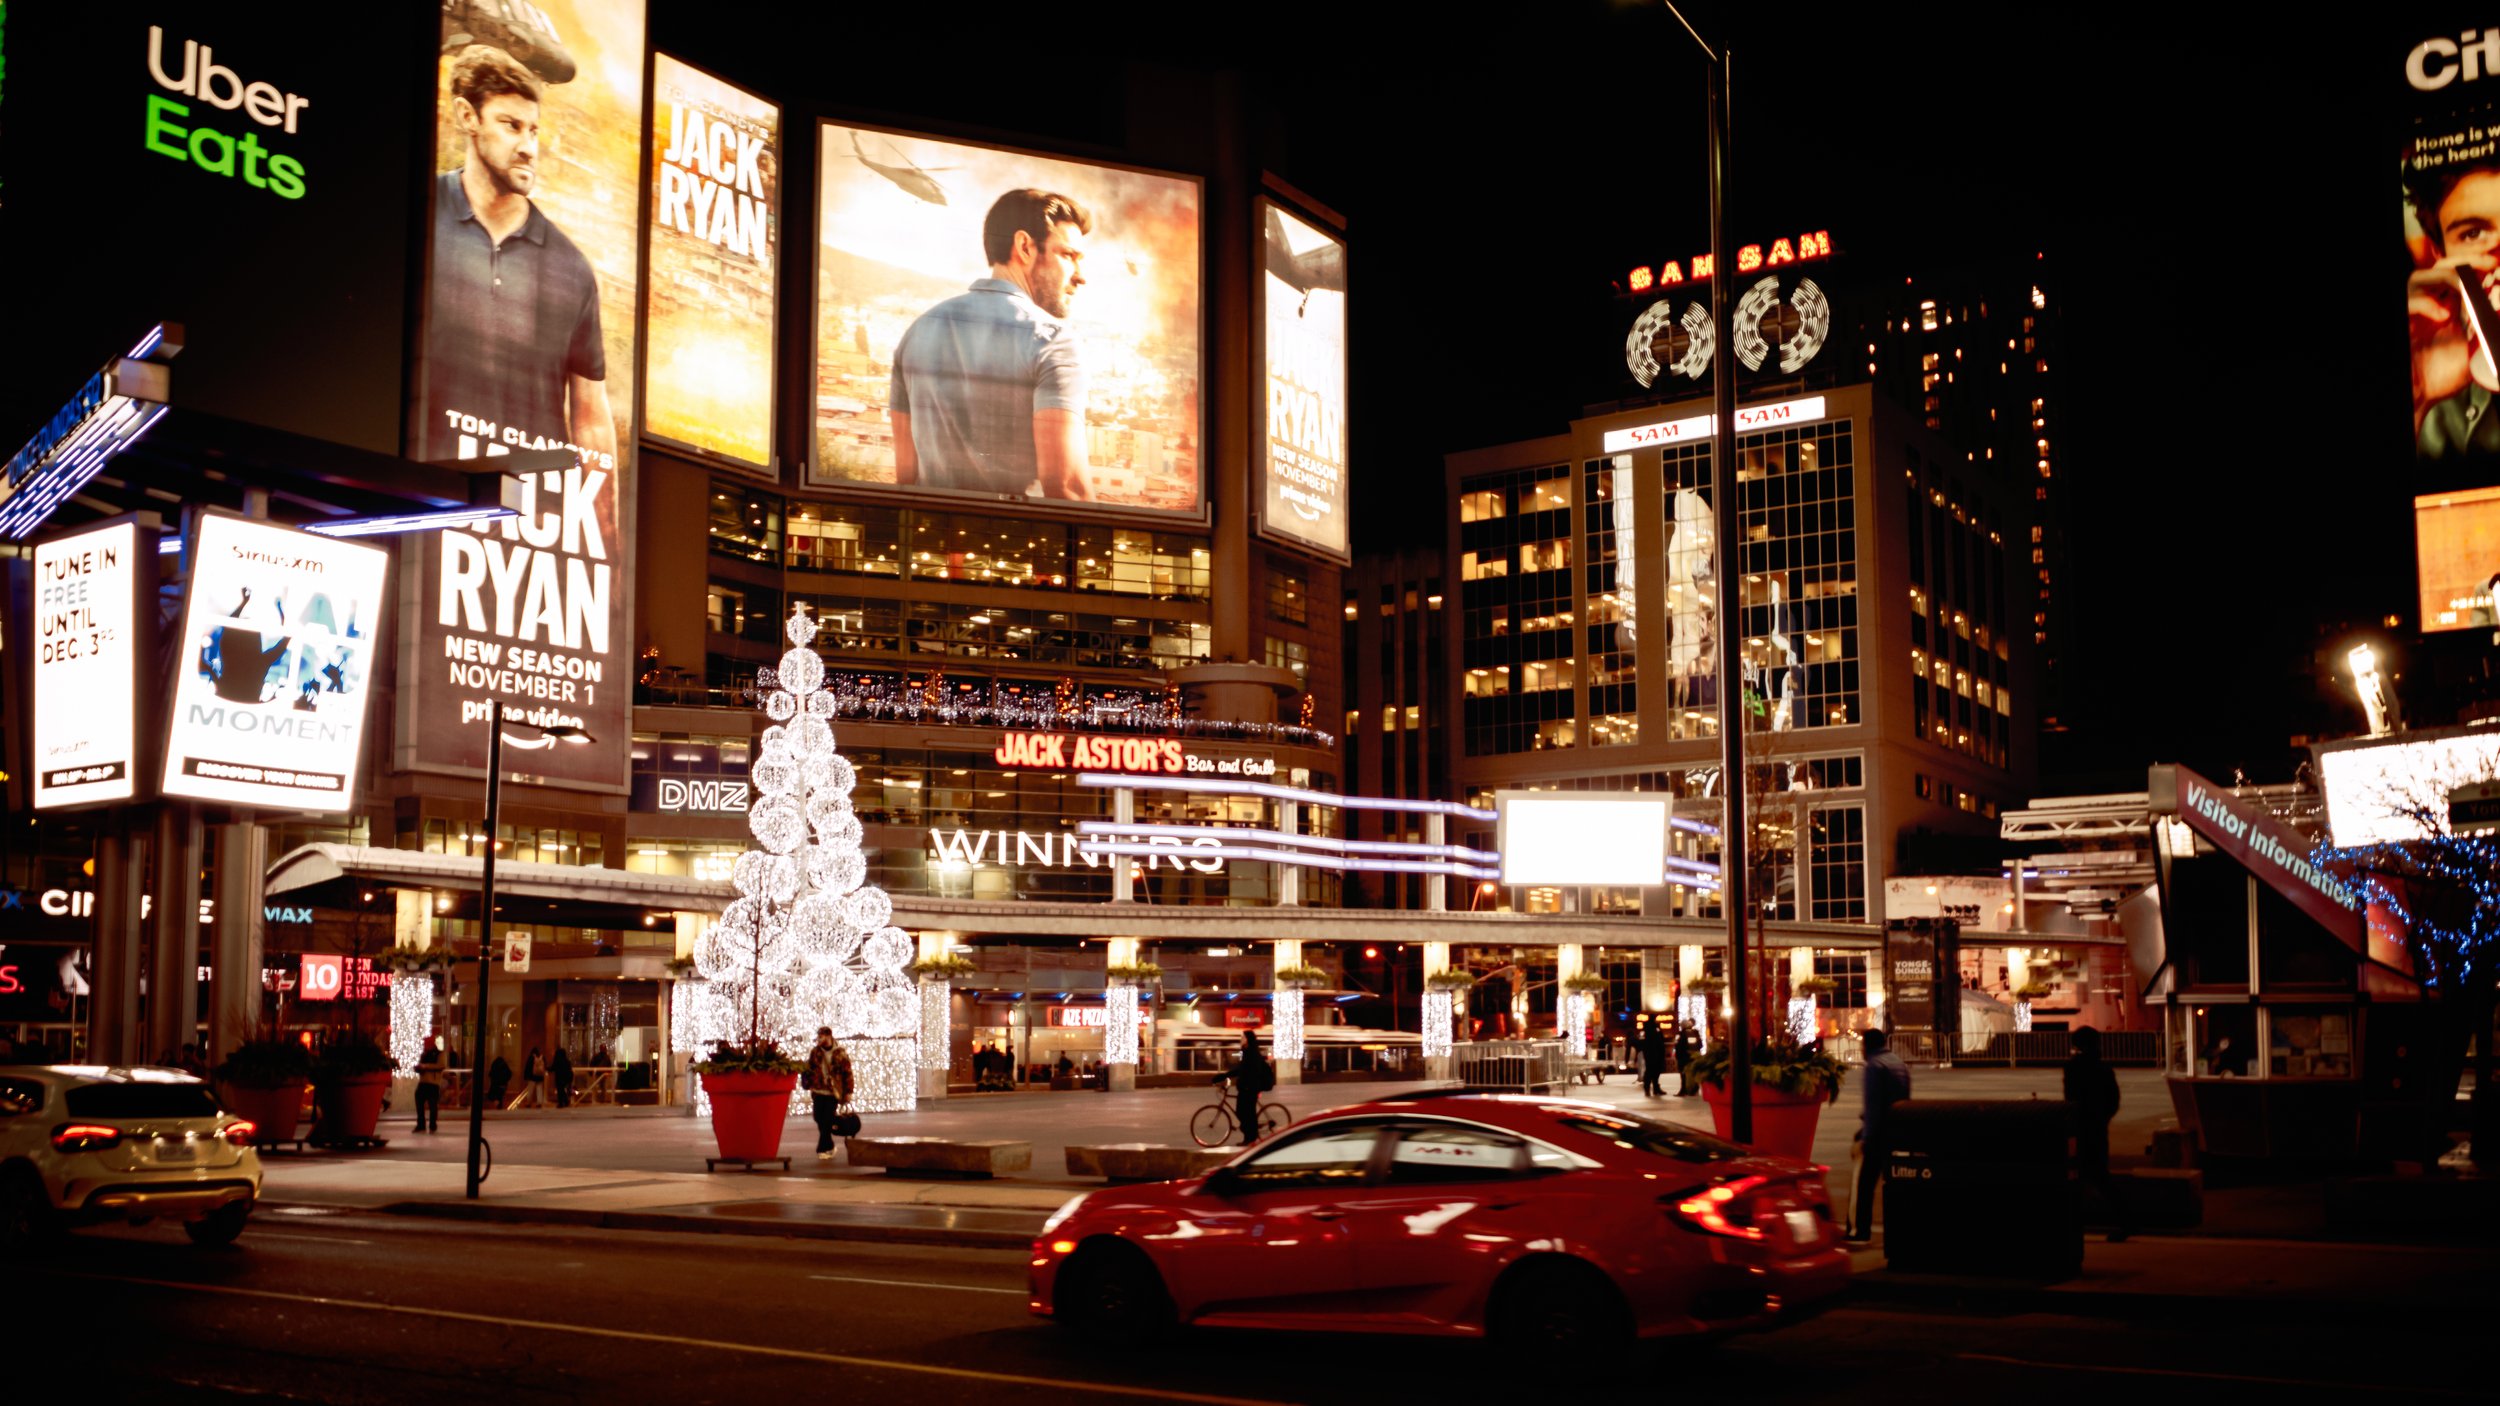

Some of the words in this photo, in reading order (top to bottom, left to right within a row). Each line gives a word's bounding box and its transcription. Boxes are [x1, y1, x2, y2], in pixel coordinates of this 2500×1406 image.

[2406, 27, 2500, 91] Cit
[147, 25, 310, 134] Uber
[145, 94, 306, 200] Eats
[664, 102, 765, 199] JACK
[2414, 153, 2444, 170] the
[2448, 141, 2495, 163] heart
[2416, 132, 2465, 152] Home
[2469, 127, 2483, 142] is
[659, 161, 767, 262] RYAN
[1629, 254, 1714, 291] SAM
[1737, 230, 1832, 271] SAM
[446, 409, 497, 439] TOM
[503, 426, 614, 470] CLANY'S
[1270, 377, 1341, 465] RYAN
[1631, 424, 1679, 444] SAM
[1740, 405, 1790, 424] SAM
[1272, 443, 1297, 466] NEW
[1298, 453, 1338, 482] SEASON
[1275, 460, 1328, 493] NOVEMBER
[1329, 482, 1335, 496] 1
[1279, 485, 1306, 506] prime
[1306, 491, 1331, 514] video
[43, 552, 92, 582] TUNE
[99, 546, 117, 571] IN
[43, 580, 88, 608] FREE
[439, 528, 611, 654] RYAN
[43, 607, 96, 637] UNTIL
[923, 620, 974, 640] DMZ
[43, 637, 83, 665] DEC.
[445, 635, 502, 665] NEW
[507, 646, 602, 683] SEASON
[450, 661, 577, 703] NOVEMBER
[584, 684, 594, 706] 1
[188, 703, 353, 744] MOMENT
[995, 732, 1066, 768] JACK
[1072, 736, 1183, 773] ASTOR'S
[1185, 754, 1215, 772] Bar
[1217, 757, 1240, 773] and
[1242, 758, 1276, 776] Grill
[658, 779, 749, 812] DMZ
[930, 828, 1224, 872] WINNRS
[2186, 780, 2248, 840] Visitor
[2248, 824, 2357, 911] Information
[263, 905, 314, 924] MAX
[306, 963, 338, 991] 10
[1895, 960, 1932, 968] YONGE-
[1895, 967, 1932, 975] DUNDAS
[1891, 1165, 1917, 1178] Litter
